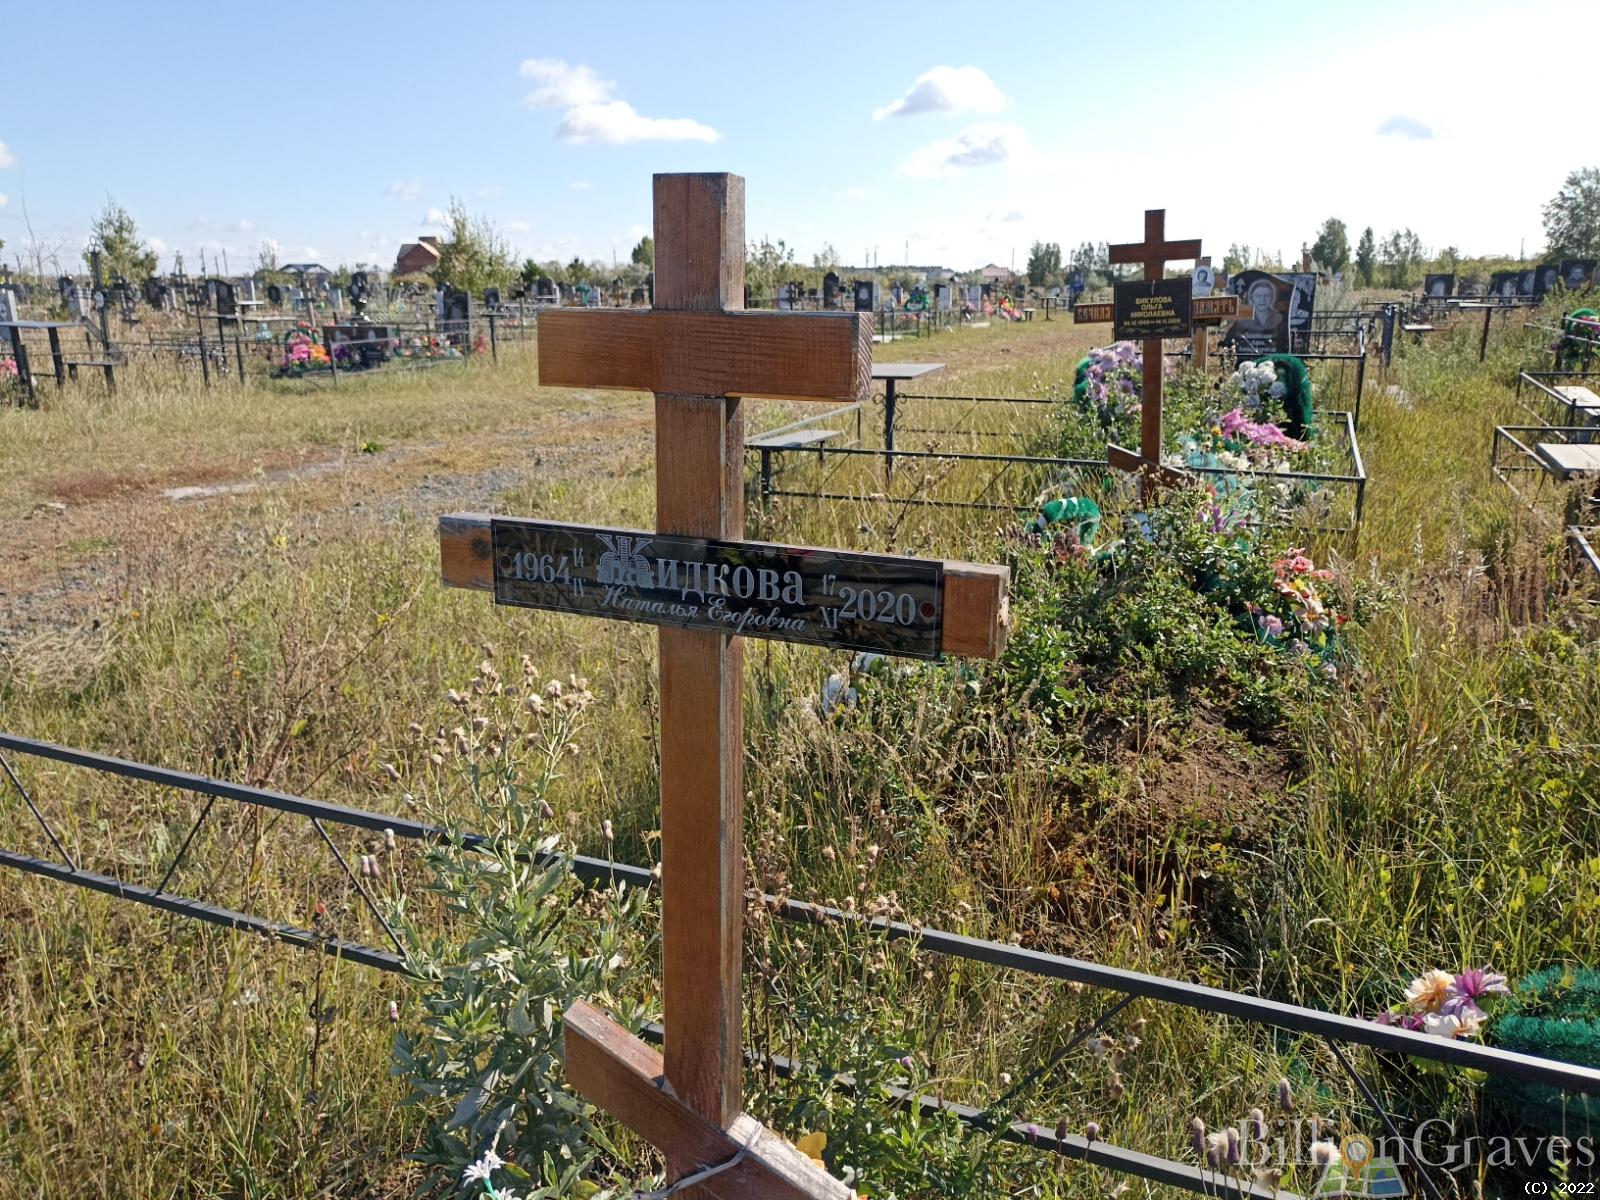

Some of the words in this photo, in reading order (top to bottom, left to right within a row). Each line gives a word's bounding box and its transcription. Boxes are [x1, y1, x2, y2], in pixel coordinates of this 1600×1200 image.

[1130, 309, 1176, 318] НИКОЛАЕВНА
[1140, 303, 1163, 311] ОЛЬГА
[513, 552, 572, 585] 1964
[595, 533, 806, 606] Жидкова
[821, 573, 837, 596] 17
[597, 584, 699, 618] Наталья
[707, 596, 806, 634] Егоровна
[819, 606, 839, 629] XI
[838, 586, 916, 626] 2020
